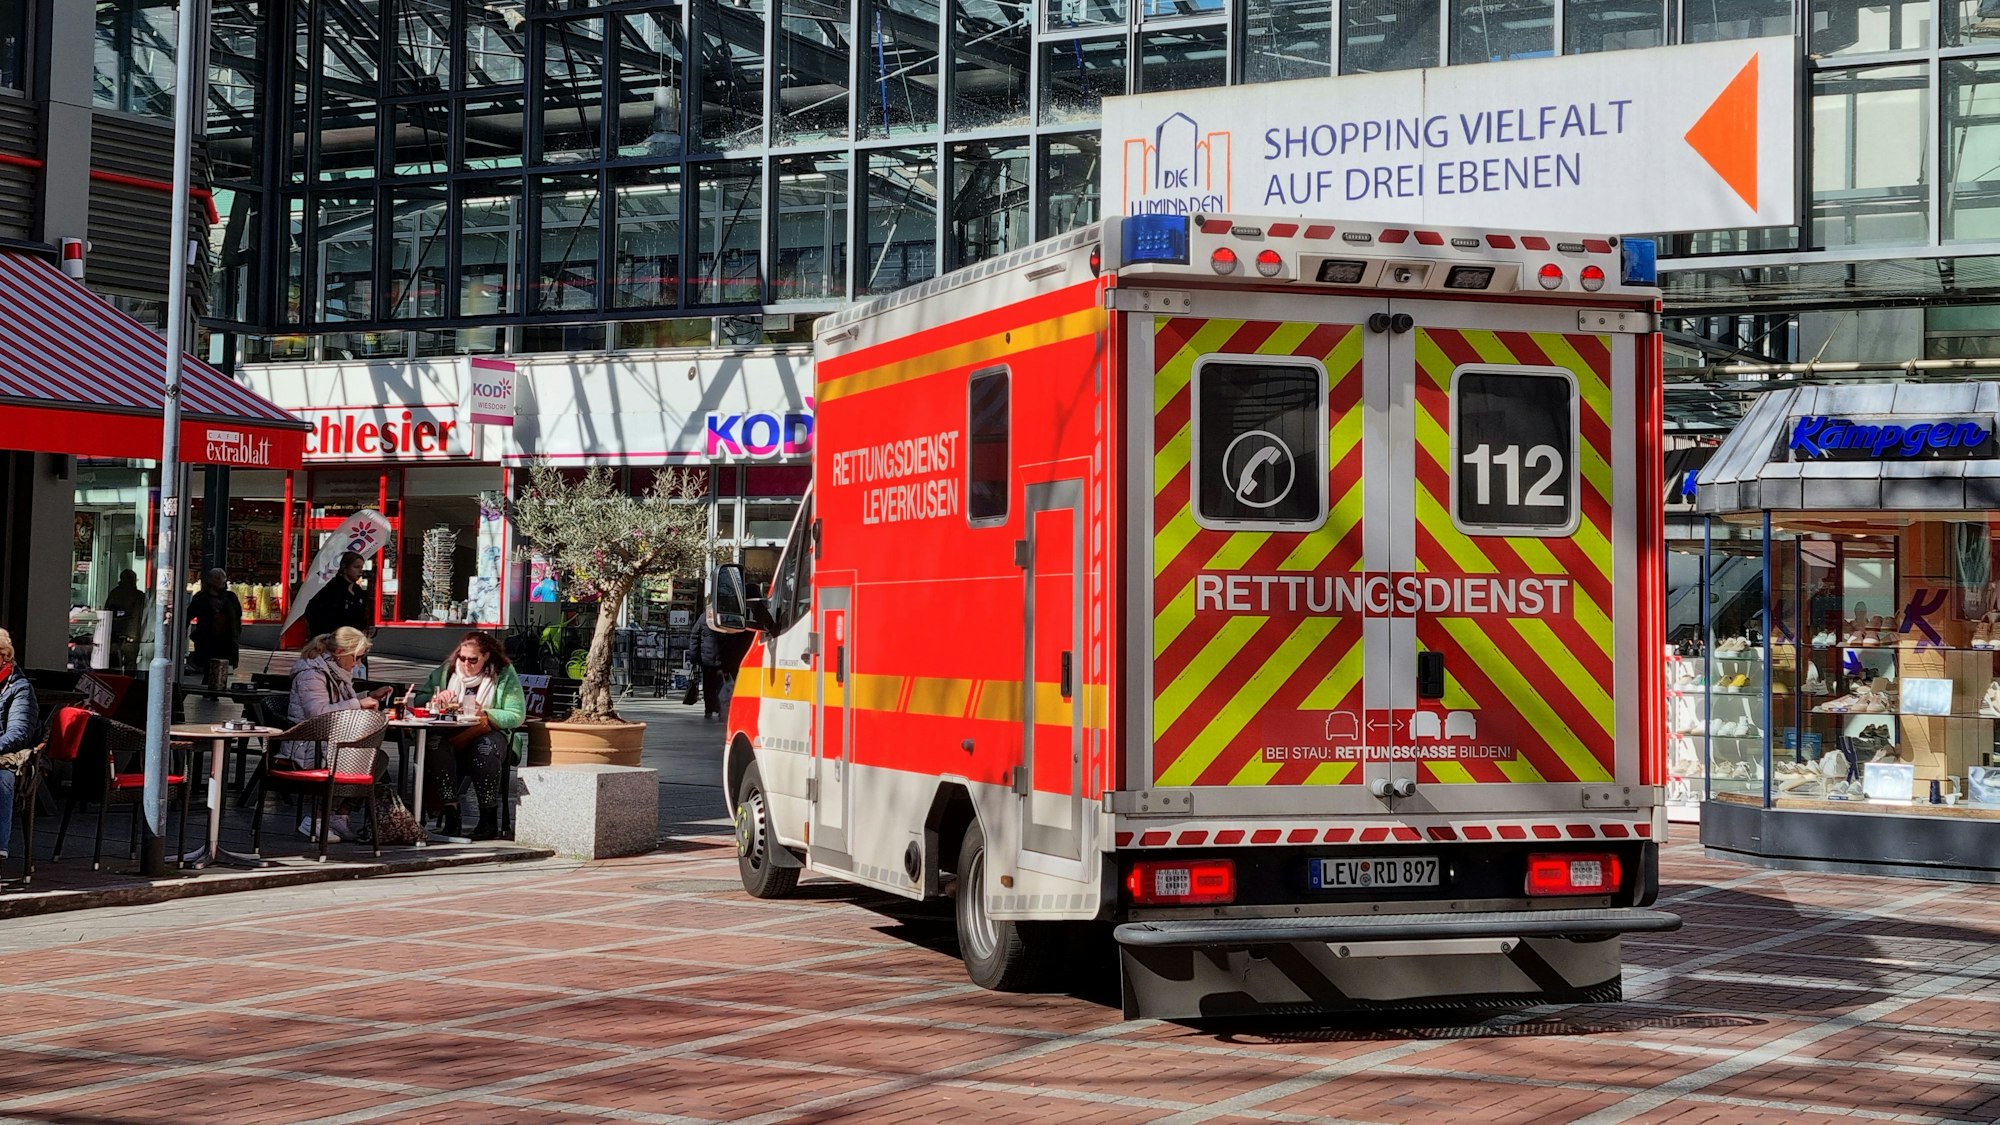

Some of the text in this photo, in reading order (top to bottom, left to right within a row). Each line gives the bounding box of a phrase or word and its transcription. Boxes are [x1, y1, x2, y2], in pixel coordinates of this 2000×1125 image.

[1264, 99, 1633, 161] SHOPPING VIELFALT
[1164, 168, 1188, 189] DIE
[1264, 152, 1582, 206] AUF DREI EBENEN
[477, 401, 507, 411] WIESDORF
[206, 436, 272, 465] extrablatt
[208, 432, 239, 442] CAFE
[303, 411, 457, 454] chlesier
[707, 412, 814, 456] KOD
[1789, 416, 1990, 458] Kämpgen
[832, 430, 959, 487] RETTUNGSDIENST
[1463, 443, 1565, 507] 112
[863, 477, 958, 525] LEVERKUSEN
[1196, 574, 1568, 614] RETTUNGSDIENST
[1266, 745, 1511, 760] BEI STAU: RETTUNGSGASSE BILDEN!
[1323, 862, 1359, 885] LEV
[1374, 861, 1398, 884] RD
[1403, 860, 1437, 884] 897
